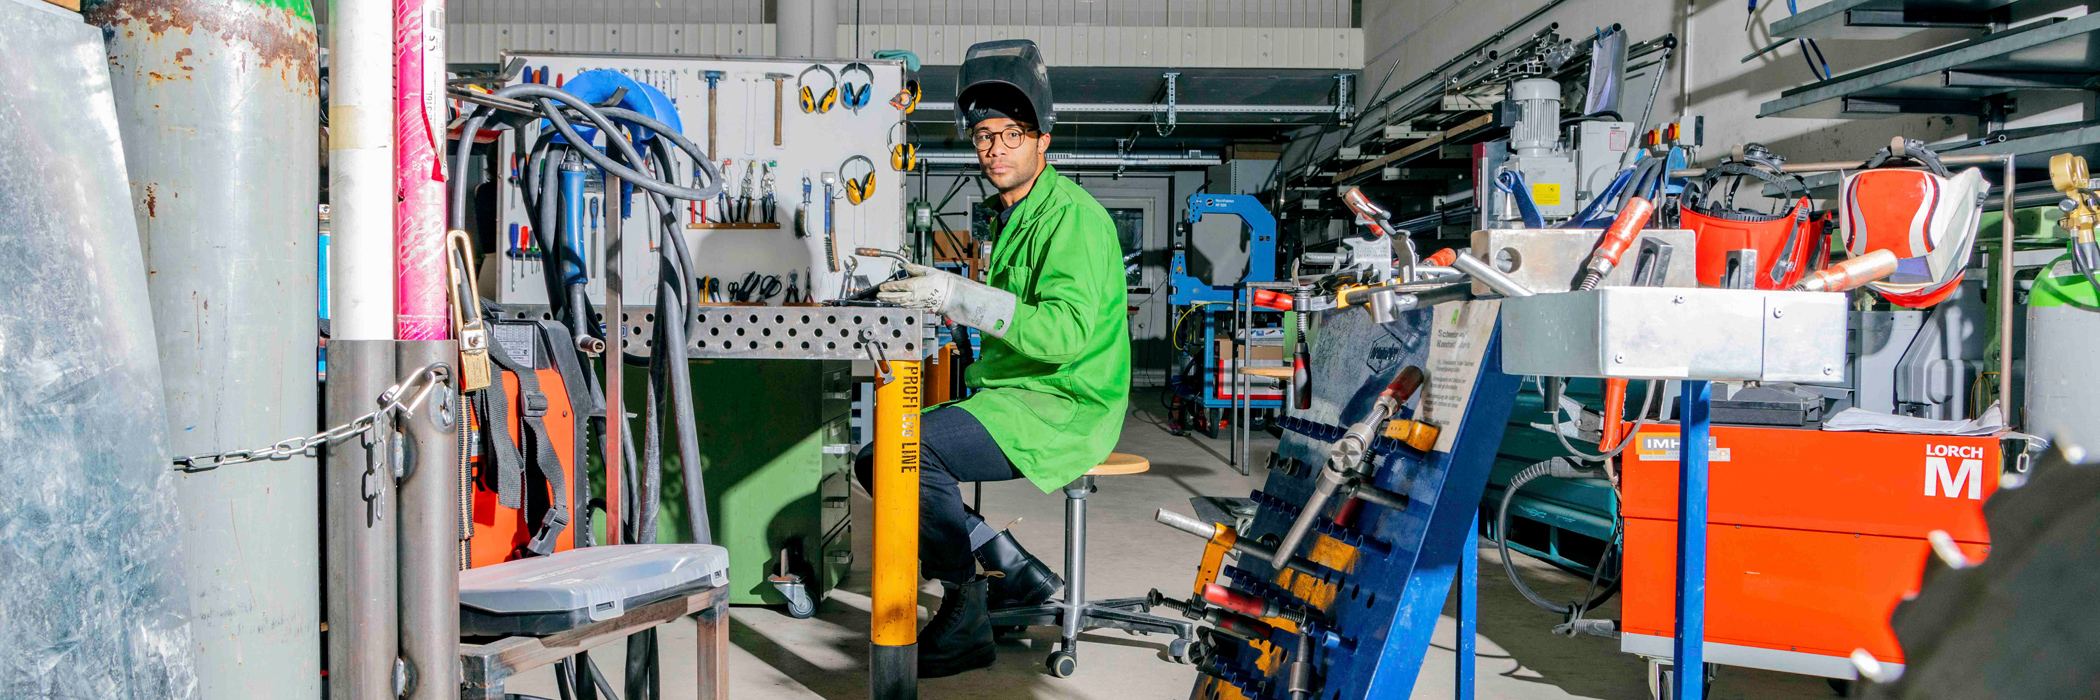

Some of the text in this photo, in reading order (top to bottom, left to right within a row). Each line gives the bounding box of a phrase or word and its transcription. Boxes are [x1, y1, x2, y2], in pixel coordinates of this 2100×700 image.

[903, 366, 918, 408] PROFI
[901, 442, 917, 474] LINE
[1926, 444, 1984, 459] LORCH
[1924, 456, 1983, 500] M
